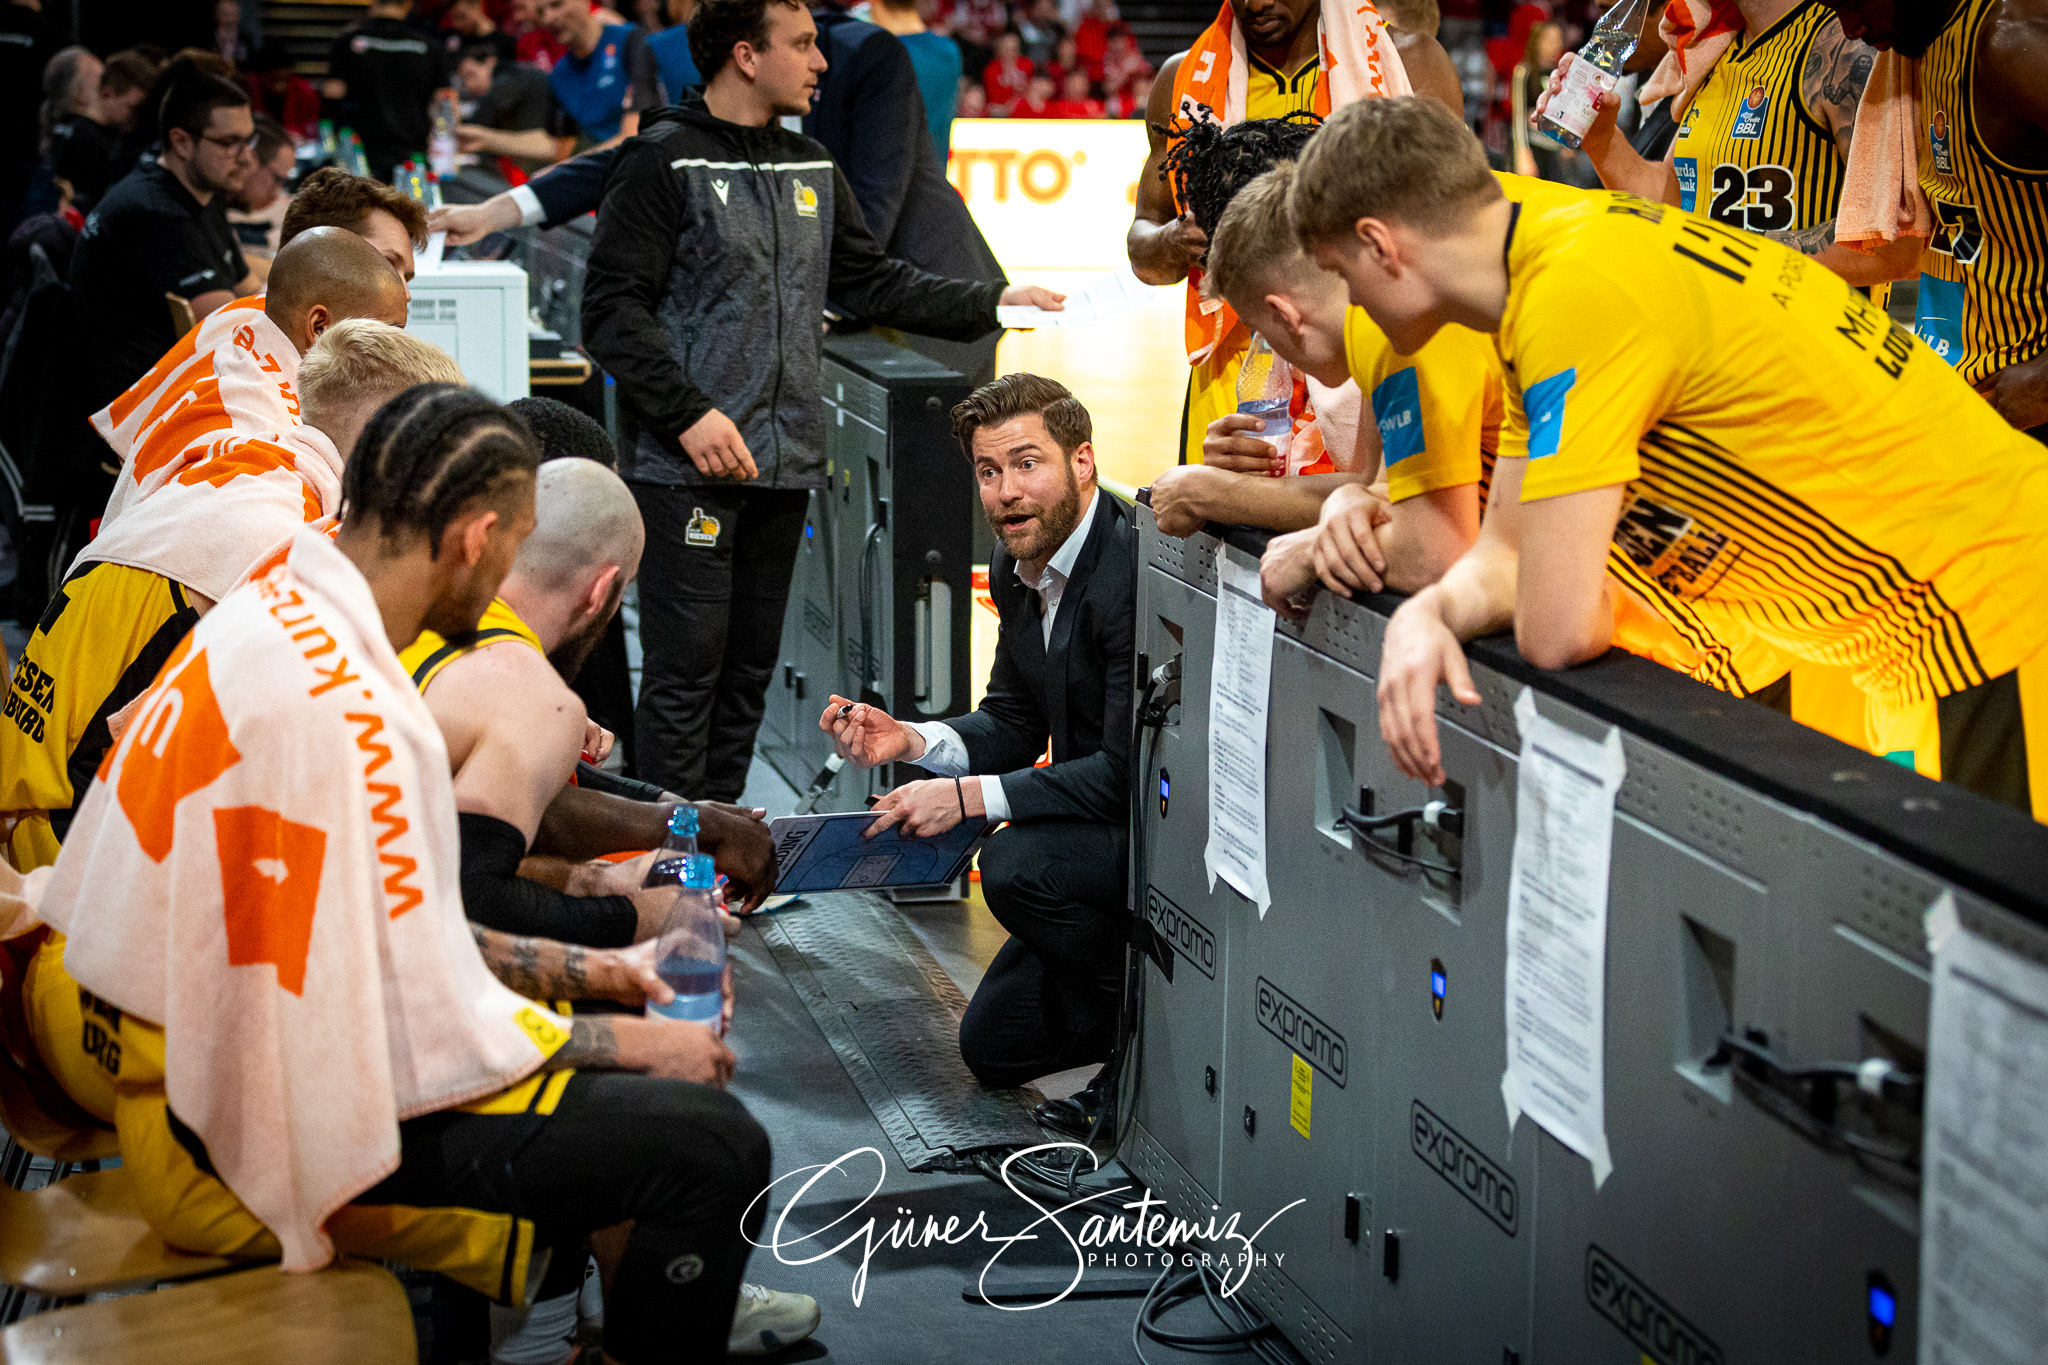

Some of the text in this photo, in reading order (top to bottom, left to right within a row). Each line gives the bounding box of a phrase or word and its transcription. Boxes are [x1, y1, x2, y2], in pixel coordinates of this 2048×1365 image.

[1735, 123, 1757, 135] BBL
[1936, 156, 1951, 170] BBL
[1708, 163, 1796, 232] 23
[1148, 893, 1215, 969] expromo
[1258, 987, 1345, 1076] expromo
[1414, 1112, 1514, 1222] expromo
